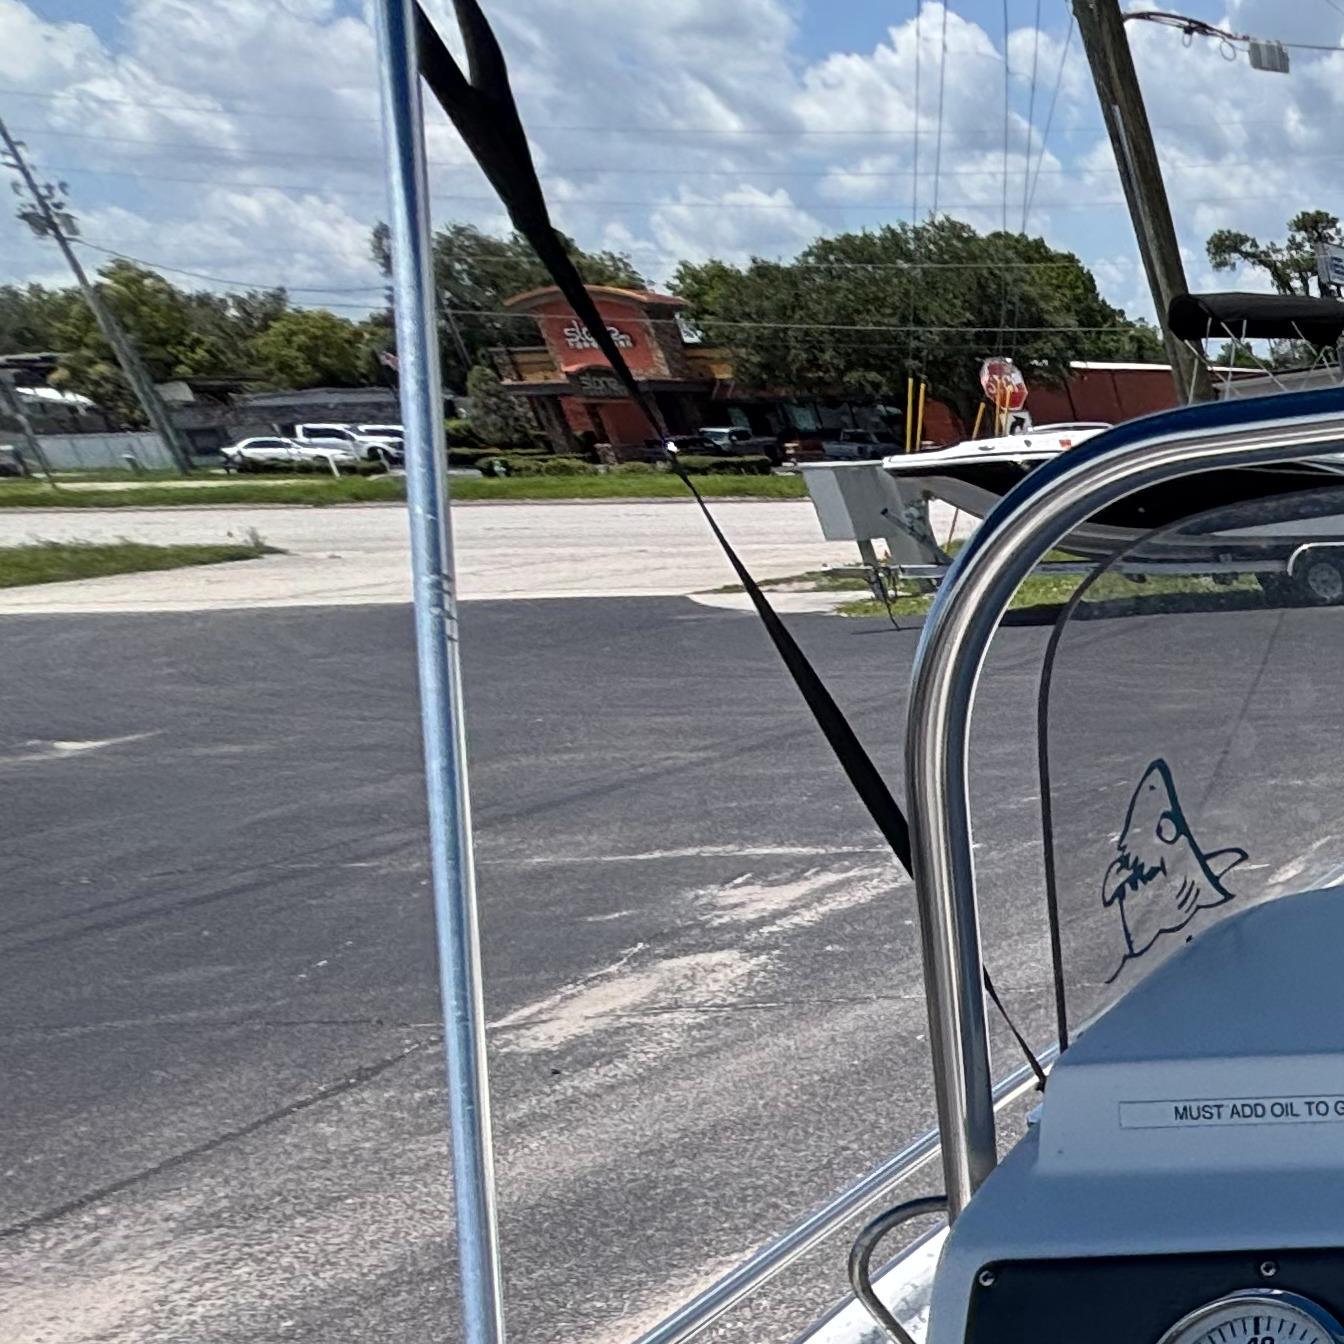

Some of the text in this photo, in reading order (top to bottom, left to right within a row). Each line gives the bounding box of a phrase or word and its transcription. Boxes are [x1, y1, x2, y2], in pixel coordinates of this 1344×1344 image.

[1174, 1104, 1224, 1121] MUST
[1230, 1102, 1266, 1119] ADD
[1270, 1101, 1300, 1118] OIL
[1304, 1100, 1329, 1117] TO
